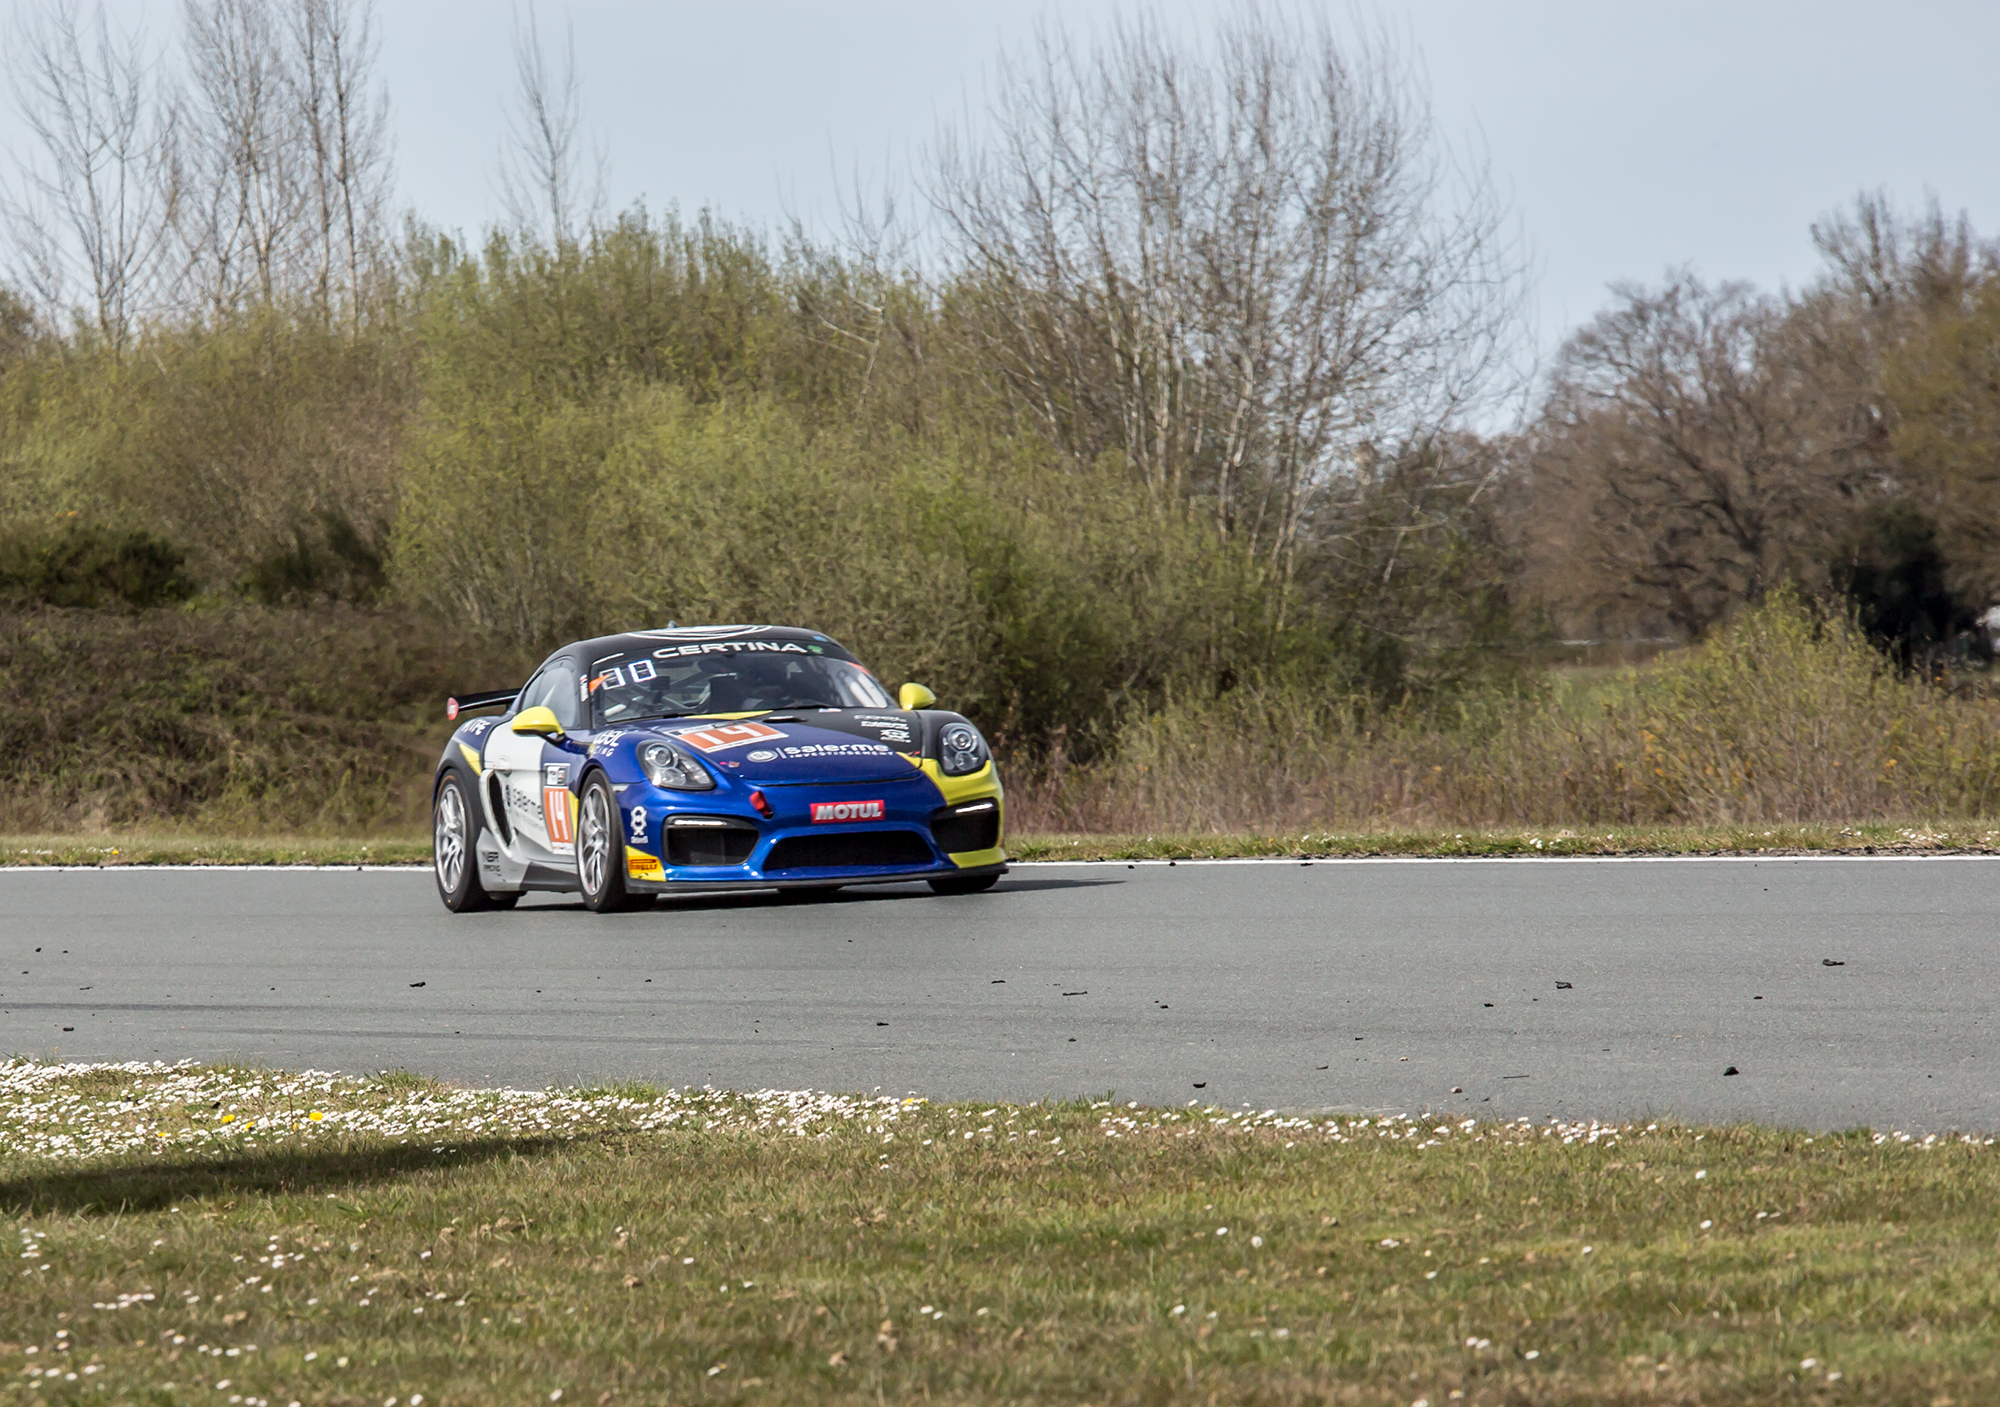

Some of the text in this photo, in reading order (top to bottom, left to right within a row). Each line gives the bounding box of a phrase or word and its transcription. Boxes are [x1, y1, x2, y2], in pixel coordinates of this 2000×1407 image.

[652, 641, 808, 659] CERTINA
[694, 724, 765, 745] 14
[783, 743, 890, 756] salerme
[548, 789, 570, 840] 14
[815, 802, 882, 821] MOTUL
